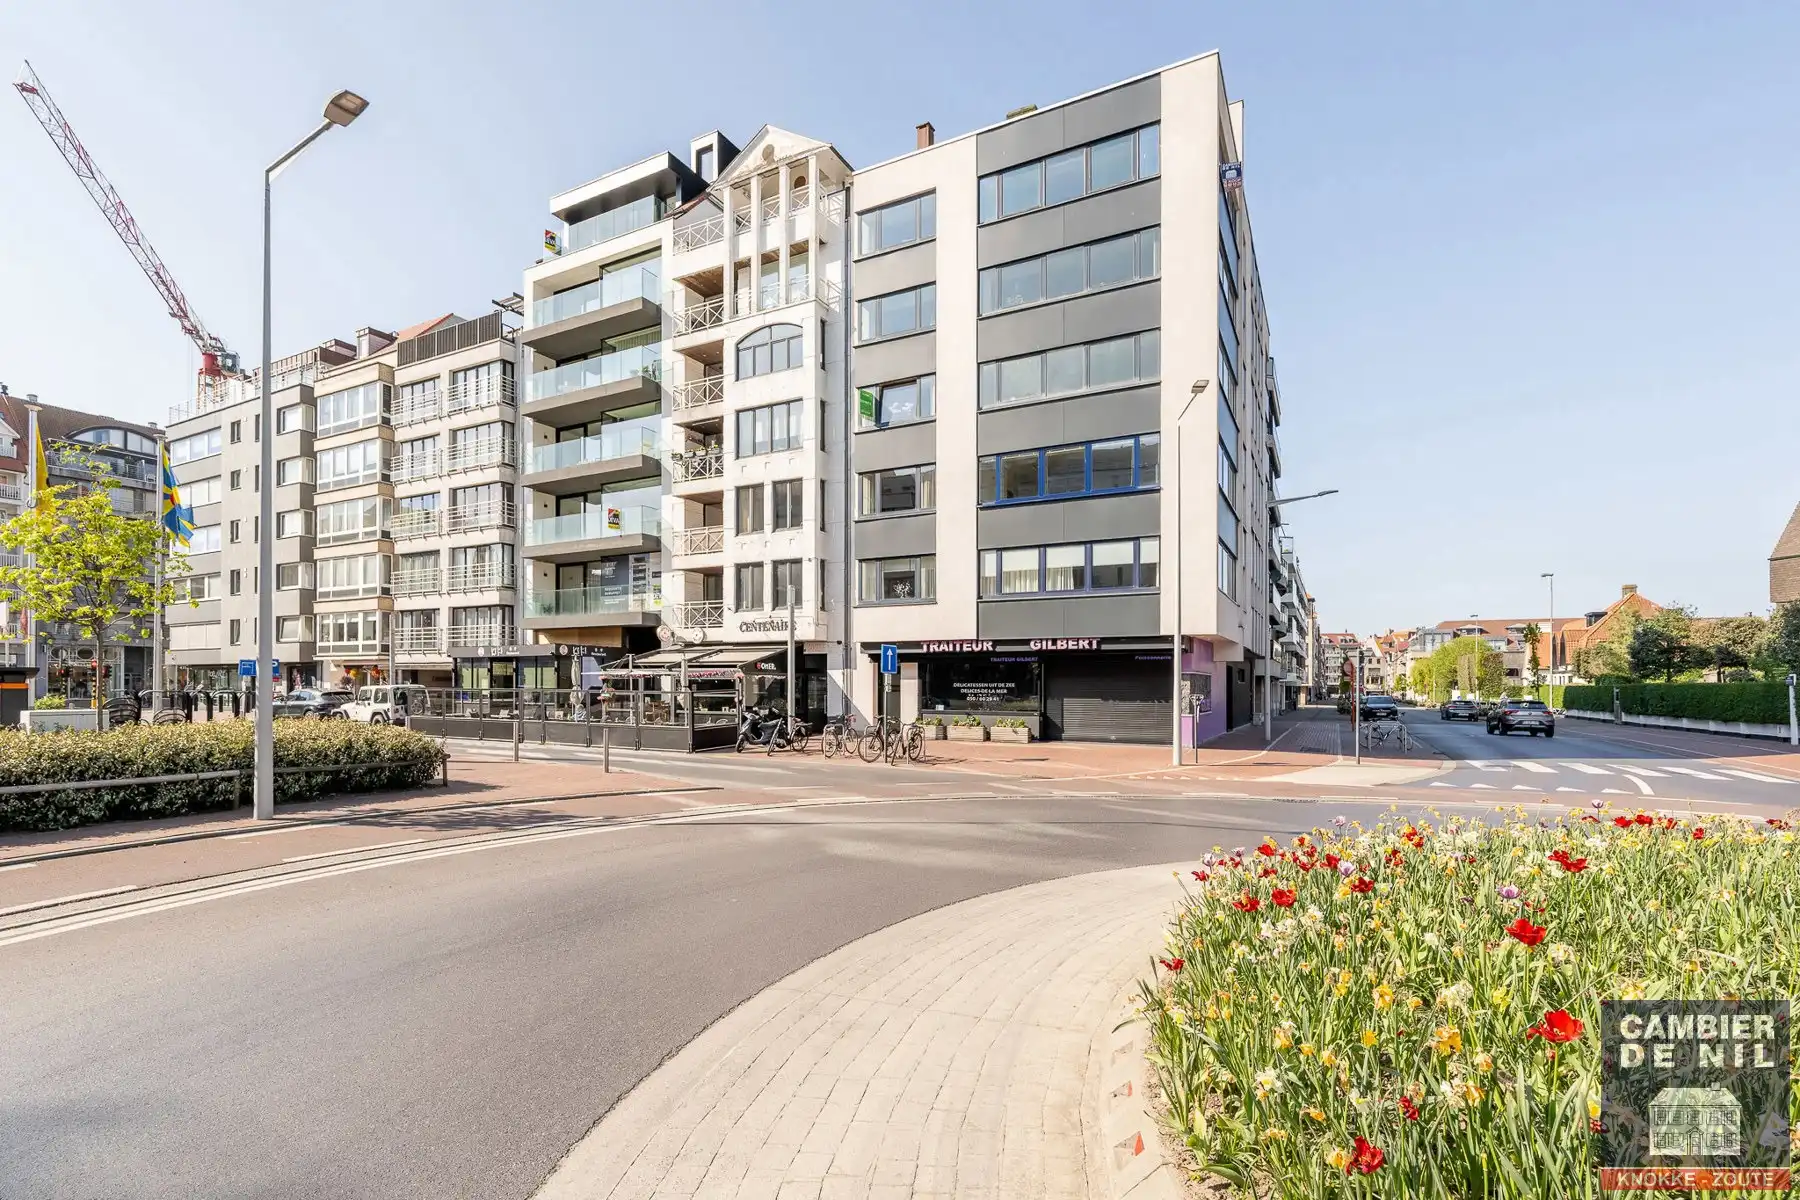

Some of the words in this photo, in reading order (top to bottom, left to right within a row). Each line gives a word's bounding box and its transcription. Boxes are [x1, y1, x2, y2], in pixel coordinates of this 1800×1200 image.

[739, 620, 797, 633] CENTENAIR
[920, 640, 993, 653] TRAITEUR
[1030, 638, 1100, 651] GILBERT
